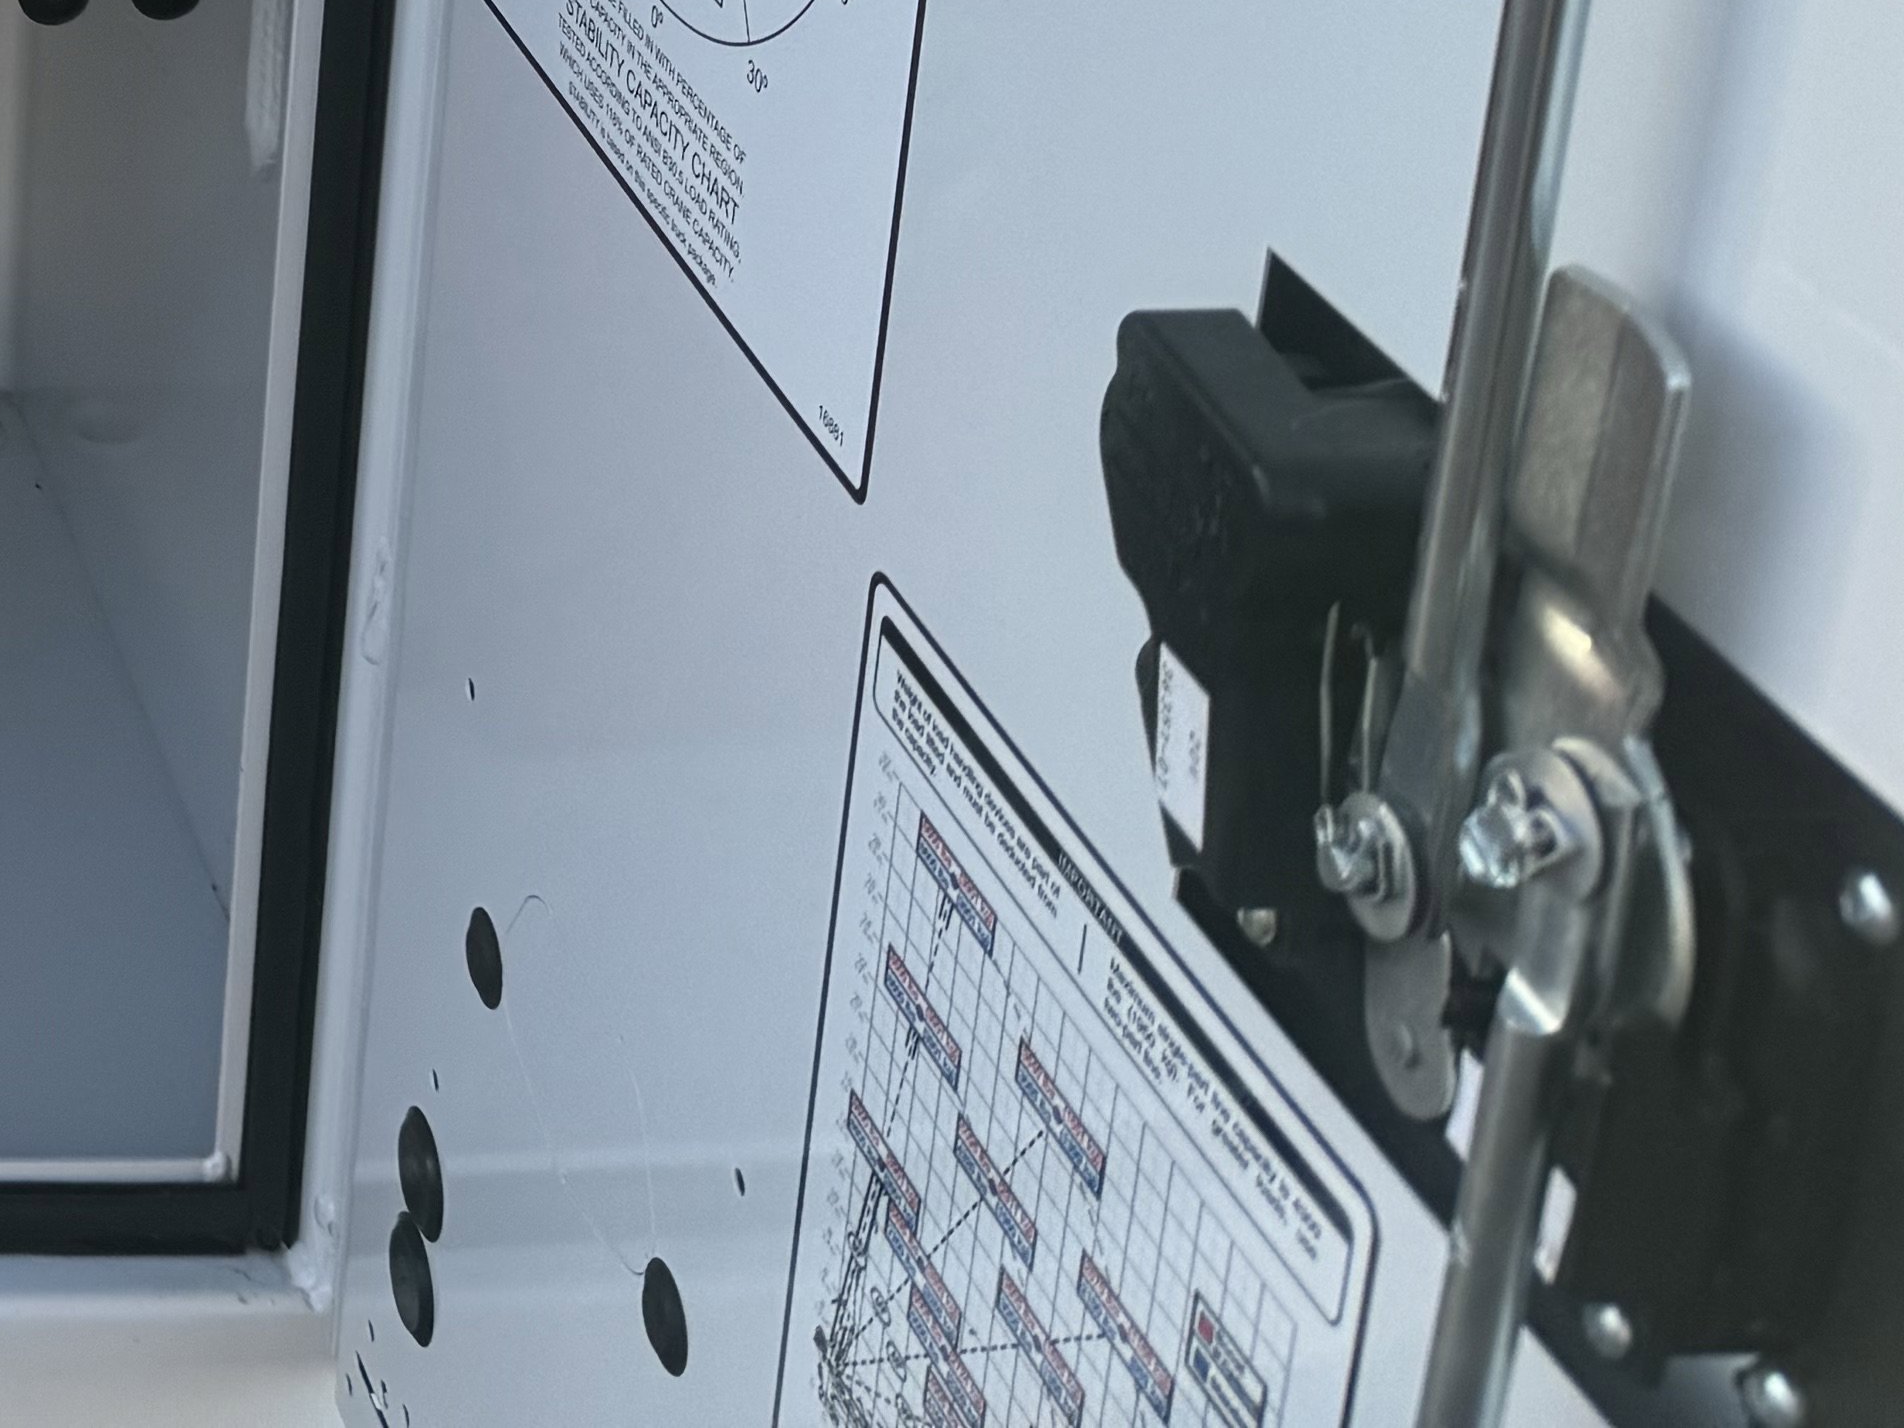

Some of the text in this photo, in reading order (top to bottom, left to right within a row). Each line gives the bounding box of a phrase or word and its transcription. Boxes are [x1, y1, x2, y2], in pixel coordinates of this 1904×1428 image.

[649, 3, 664, 30] 0°
[618, 0, 643, 40] FILLED
[645, 33, 654, 53] IN
[655, 45, 676, 81] WITH
[676, 72, 732, 151] PERCENTAGE
[733, 143, 746, 165] OF
[745, 59, 768, 94] 30°
[626, 69, 690, 161] CAPACITY
[691, 152, 739, 224] CHART
